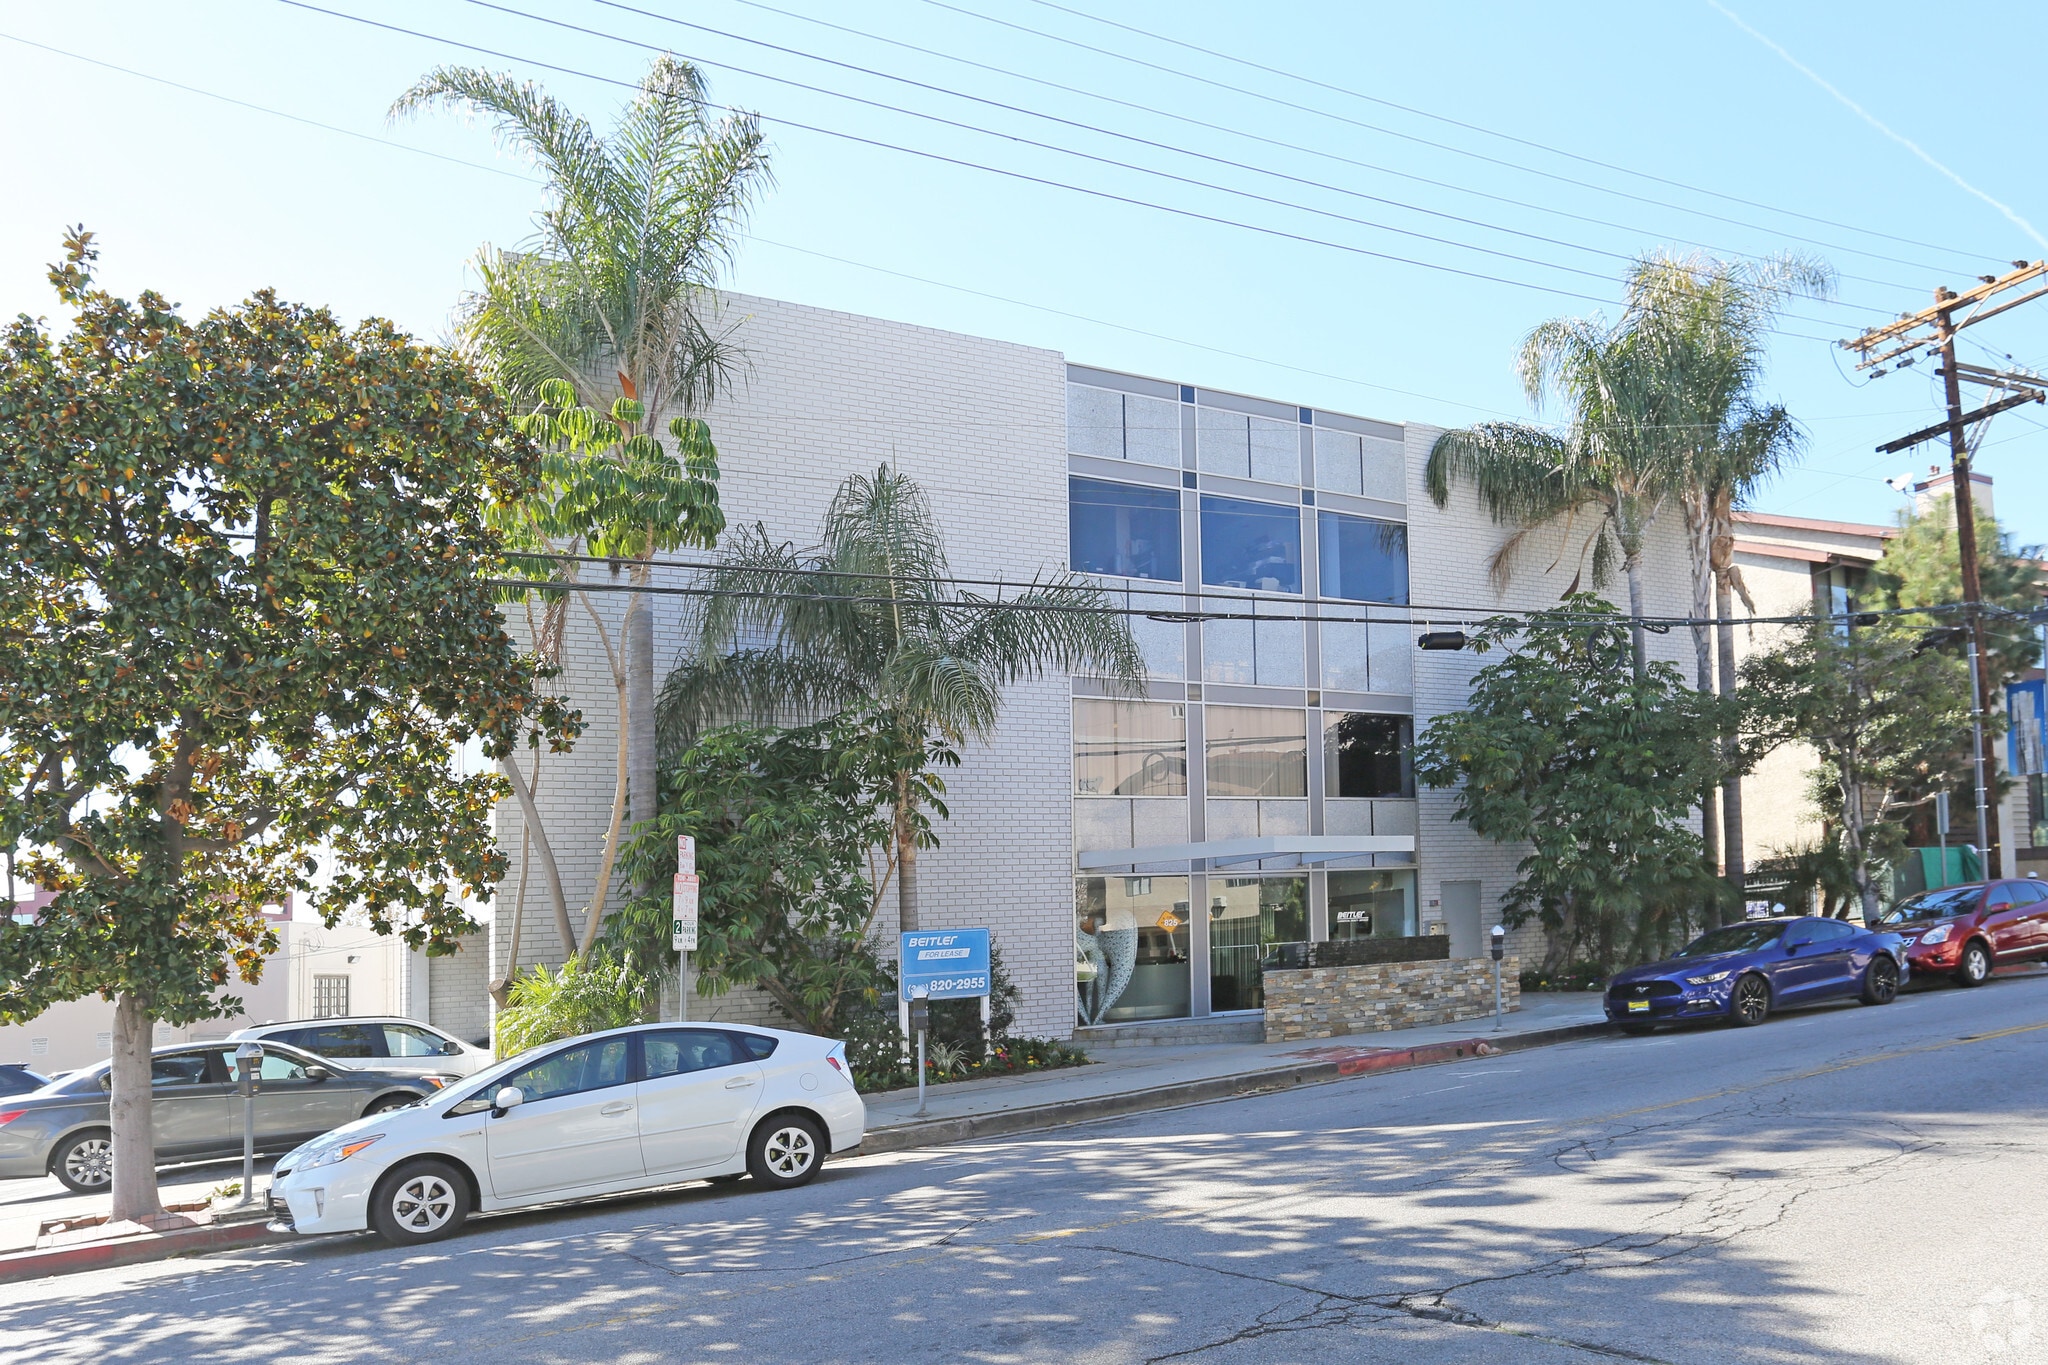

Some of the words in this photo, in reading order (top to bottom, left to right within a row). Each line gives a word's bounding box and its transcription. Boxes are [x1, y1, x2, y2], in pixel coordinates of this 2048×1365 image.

[675, 921, 681, 933] 2
[1164, 919, 1178, 927] 825
[940, 949, 964, 957] LEASE
[930, 977, 985, 992] 820-2955
